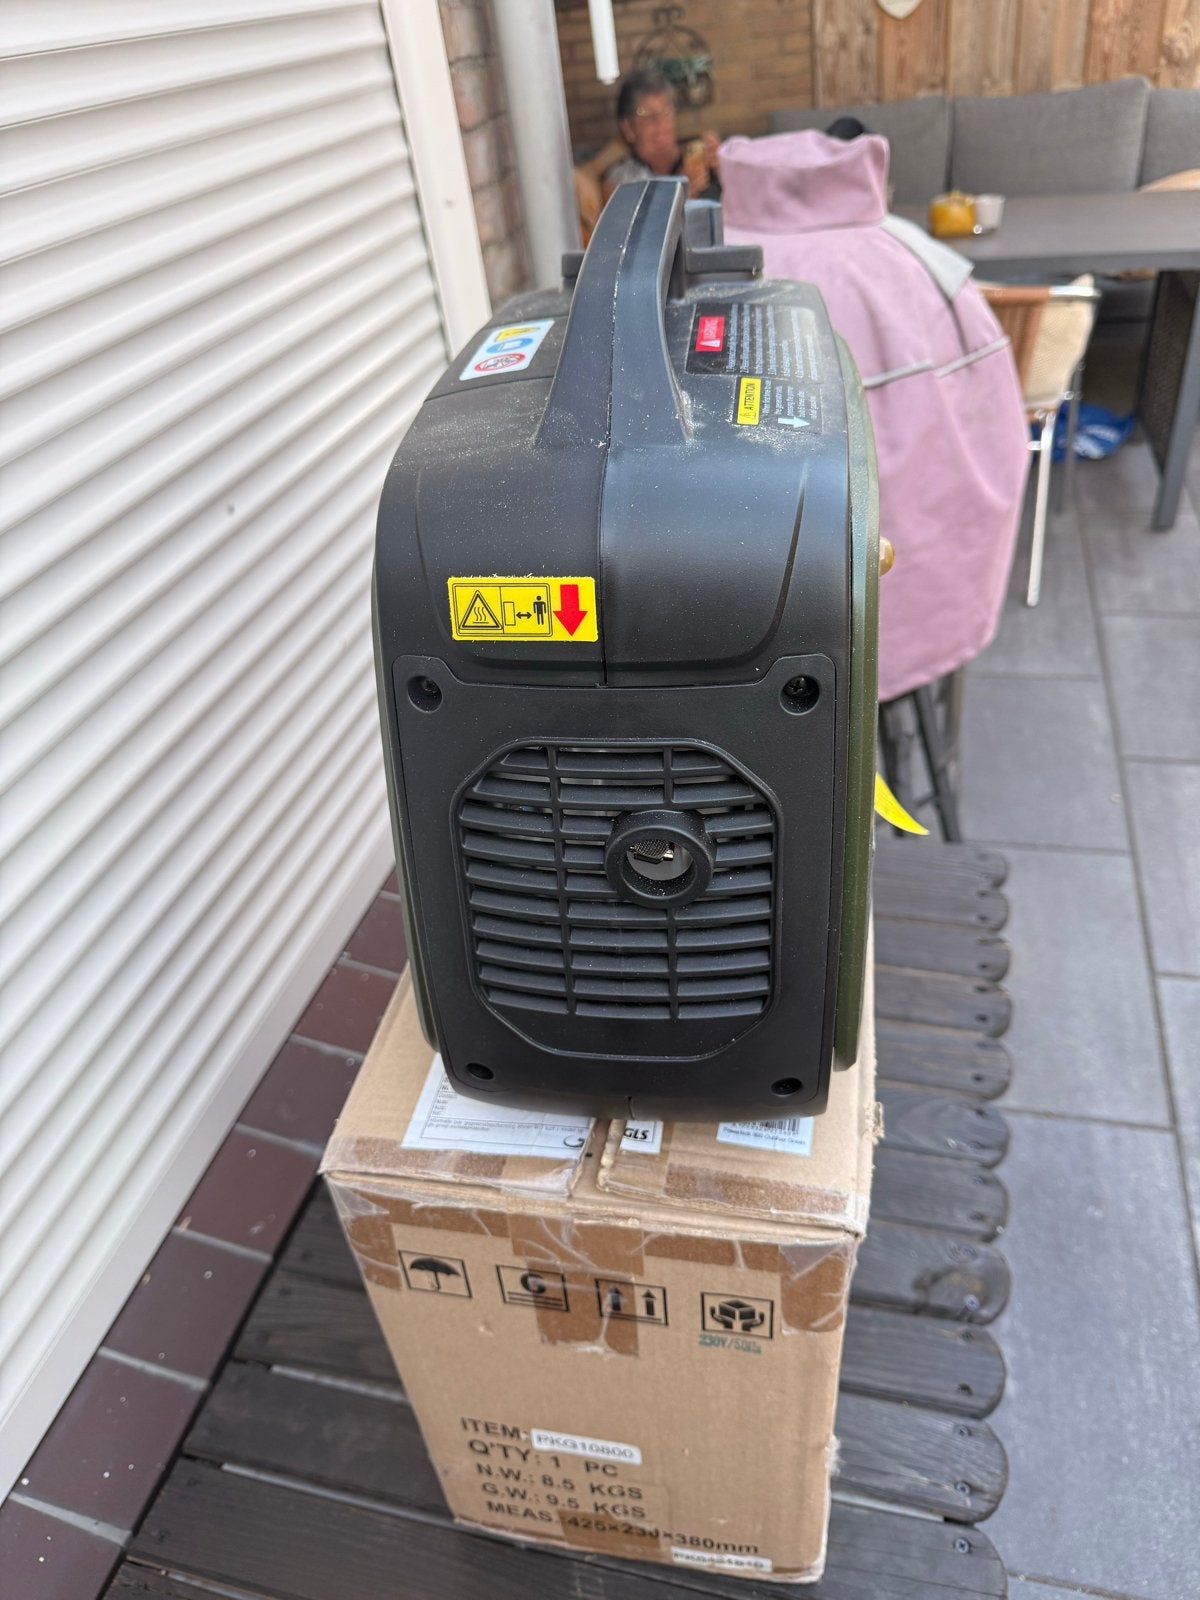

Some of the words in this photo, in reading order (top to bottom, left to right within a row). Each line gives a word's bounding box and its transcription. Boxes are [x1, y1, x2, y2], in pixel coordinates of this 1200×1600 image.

[743, 382, 756, 411] ATTENTION
[624, 1127, 649, 1140] GLS
[469, 1439, 541, 1464] Q'TY:
[550, 1456, 560, 1468] 1
[584, 1461, 619, 1477] PC
[536, 1433, 634, 1459] PKG10800
[476, 1463, 535, 1483] N.W.:
[542, 1474, 575, 1490] 8.5
[590, 1482, 643, 1499] KGS
[482, 1482, 540, 1502] G.W.:
[546, 1494, 580, 1509] 9.5
[593, 1502, 646, 1518] KGS
